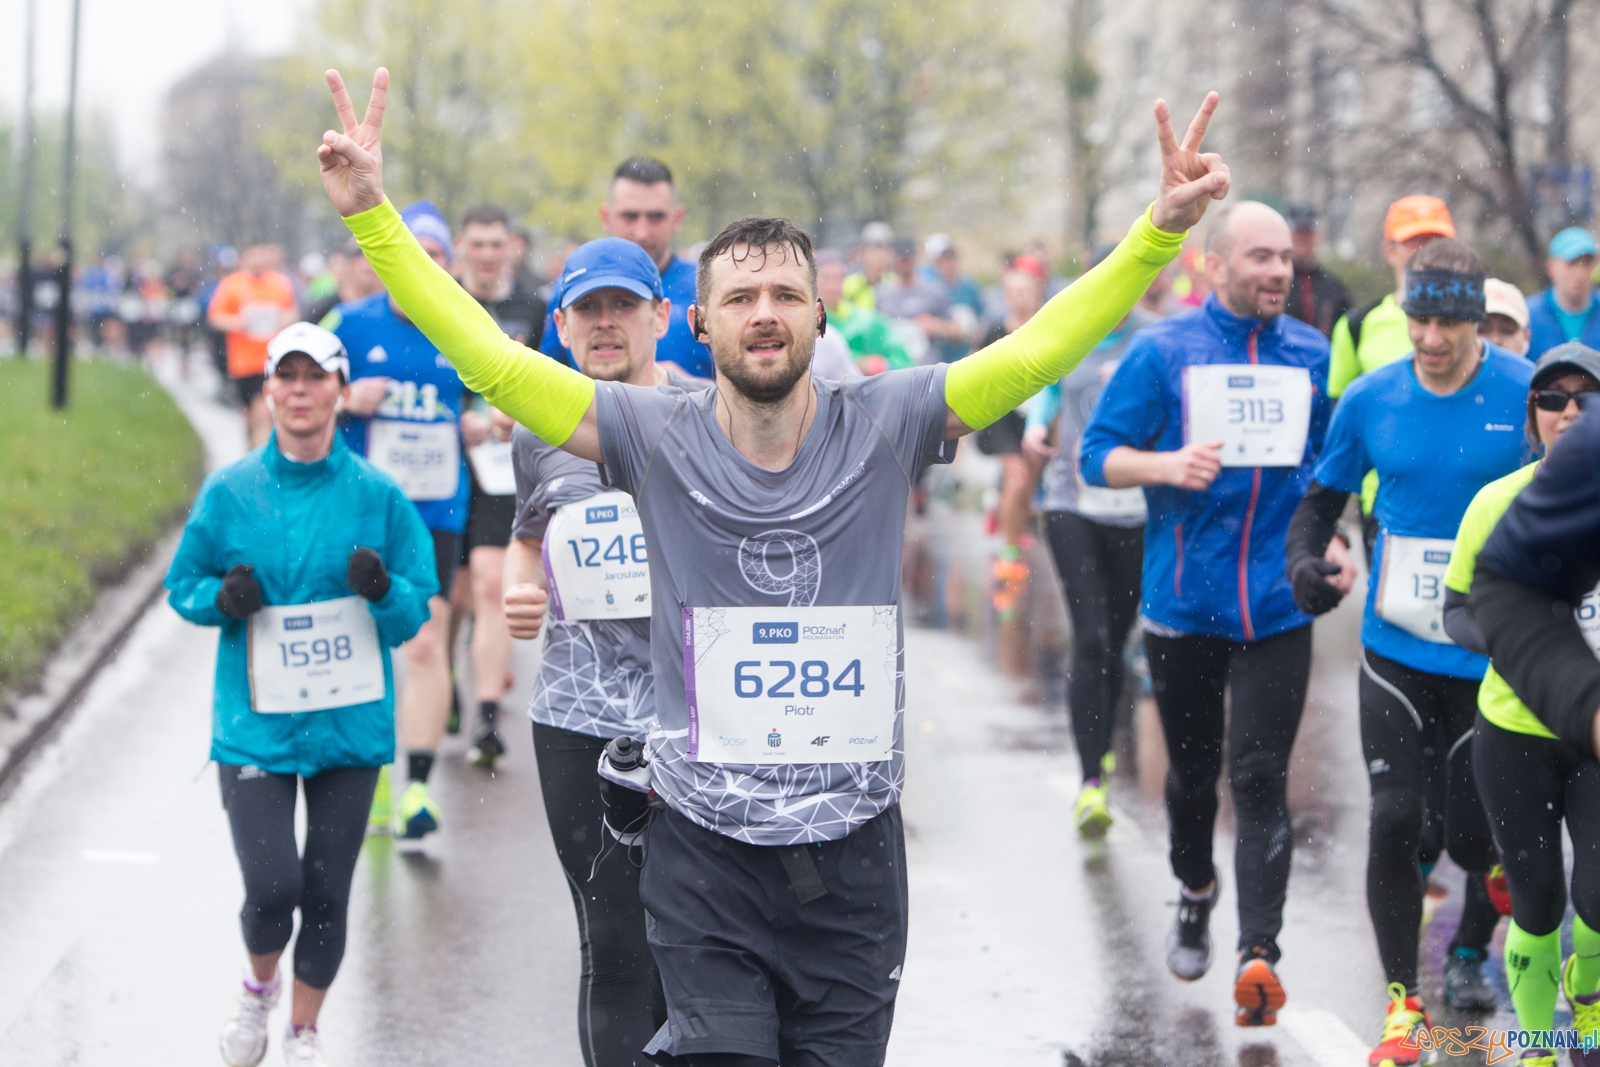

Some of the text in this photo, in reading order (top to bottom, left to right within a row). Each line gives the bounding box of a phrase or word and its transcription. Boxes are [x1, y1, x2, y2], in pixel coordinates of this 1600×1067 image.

[1228, 398, 1284, 423] 3113
[567, 534, 648, 567] 1246
[1413, 574, 1444, 599] 13
[279, 635, 352, 667] 1598
[734, 659, 865, 698] 6284
[784, 705, 815, 716] Piotr
[811, 736, 830, 747] 4F
